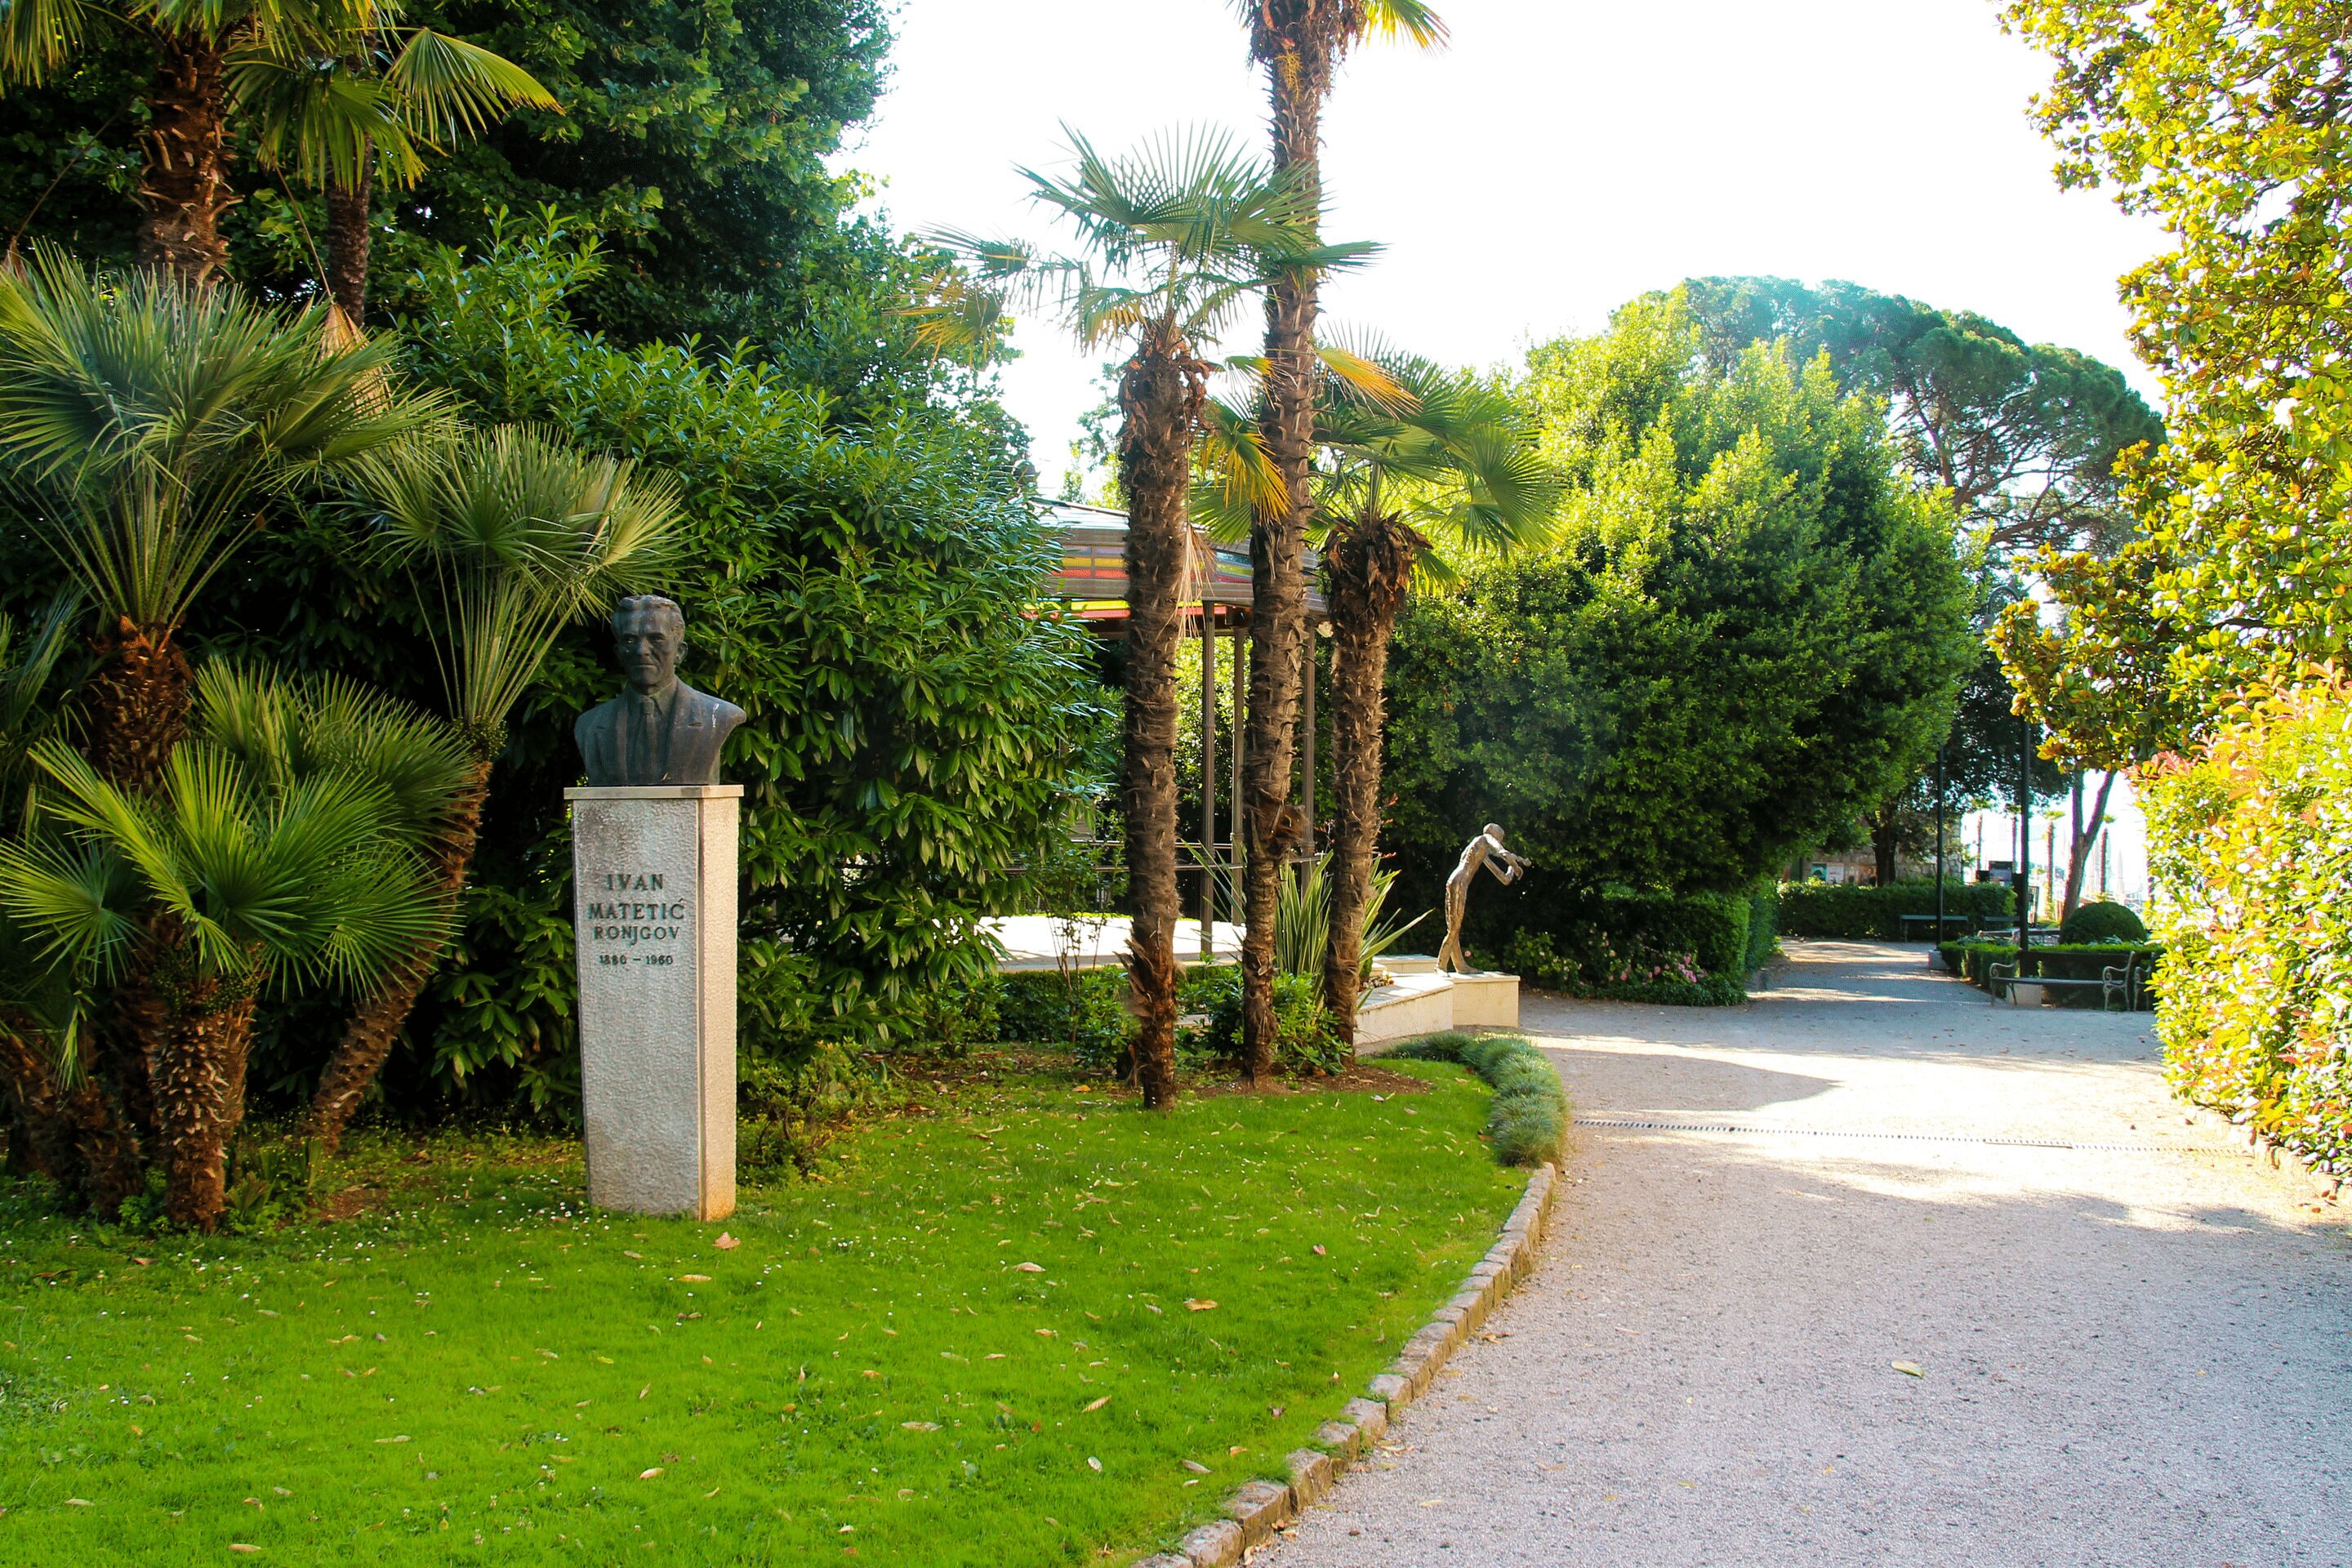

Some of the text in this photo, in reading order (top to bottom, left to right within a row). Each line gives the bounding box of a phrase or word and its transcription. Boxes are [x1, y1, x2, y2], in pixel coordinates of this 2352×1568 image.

[607, 874, 663, 890] IVAN
[588, 898, 684, 920] MATETIĆ
[594, 926, 680, 946] RONJGOV
[599, 955, 626, 965] 1880
[646, 955, 673, 965] 1960
